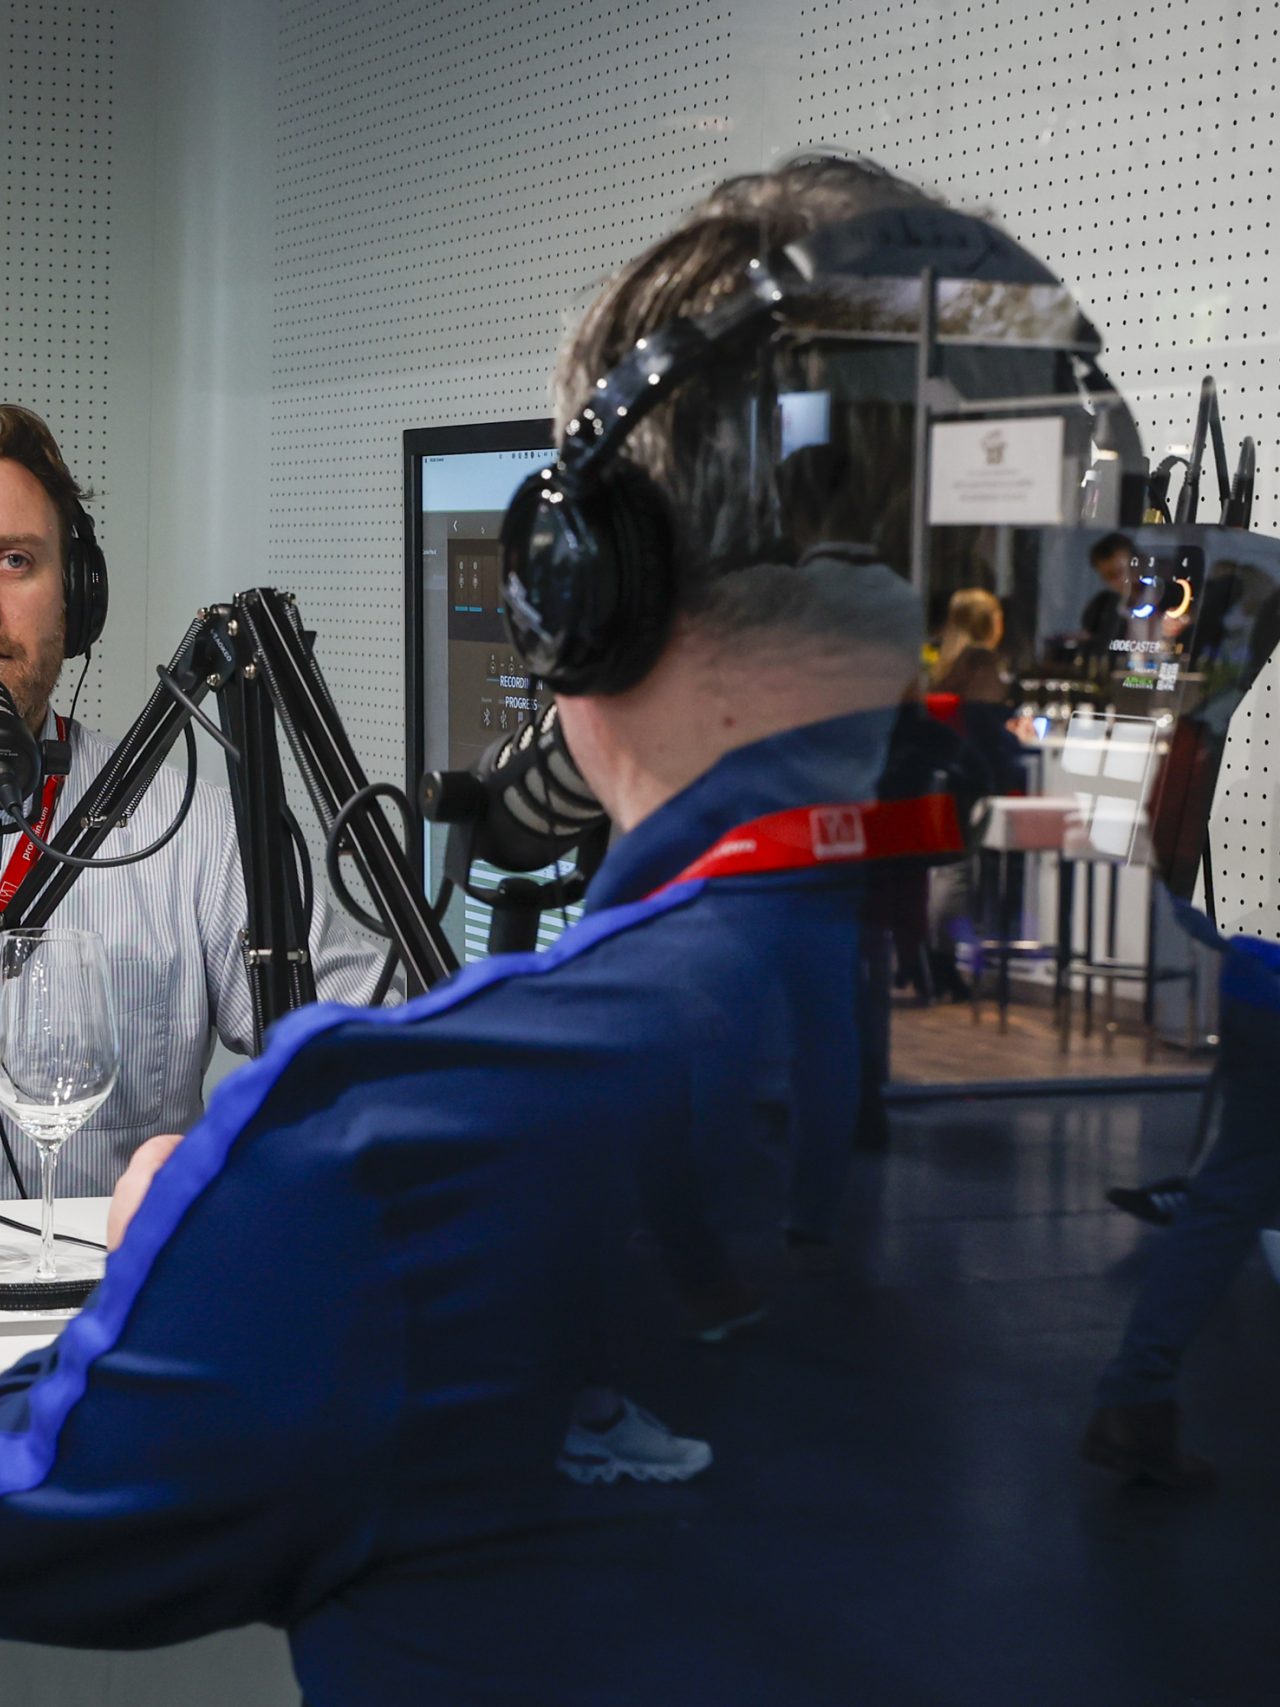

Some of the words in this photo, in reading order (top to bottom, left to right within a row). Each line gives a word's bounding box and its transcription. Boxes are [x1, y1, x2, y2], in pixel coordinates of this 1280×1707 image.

[500, 675, 530, 689] RECORDI
[505, 696, 538, 711] PROGRES
[22, 806, 49, 861] proin.com
